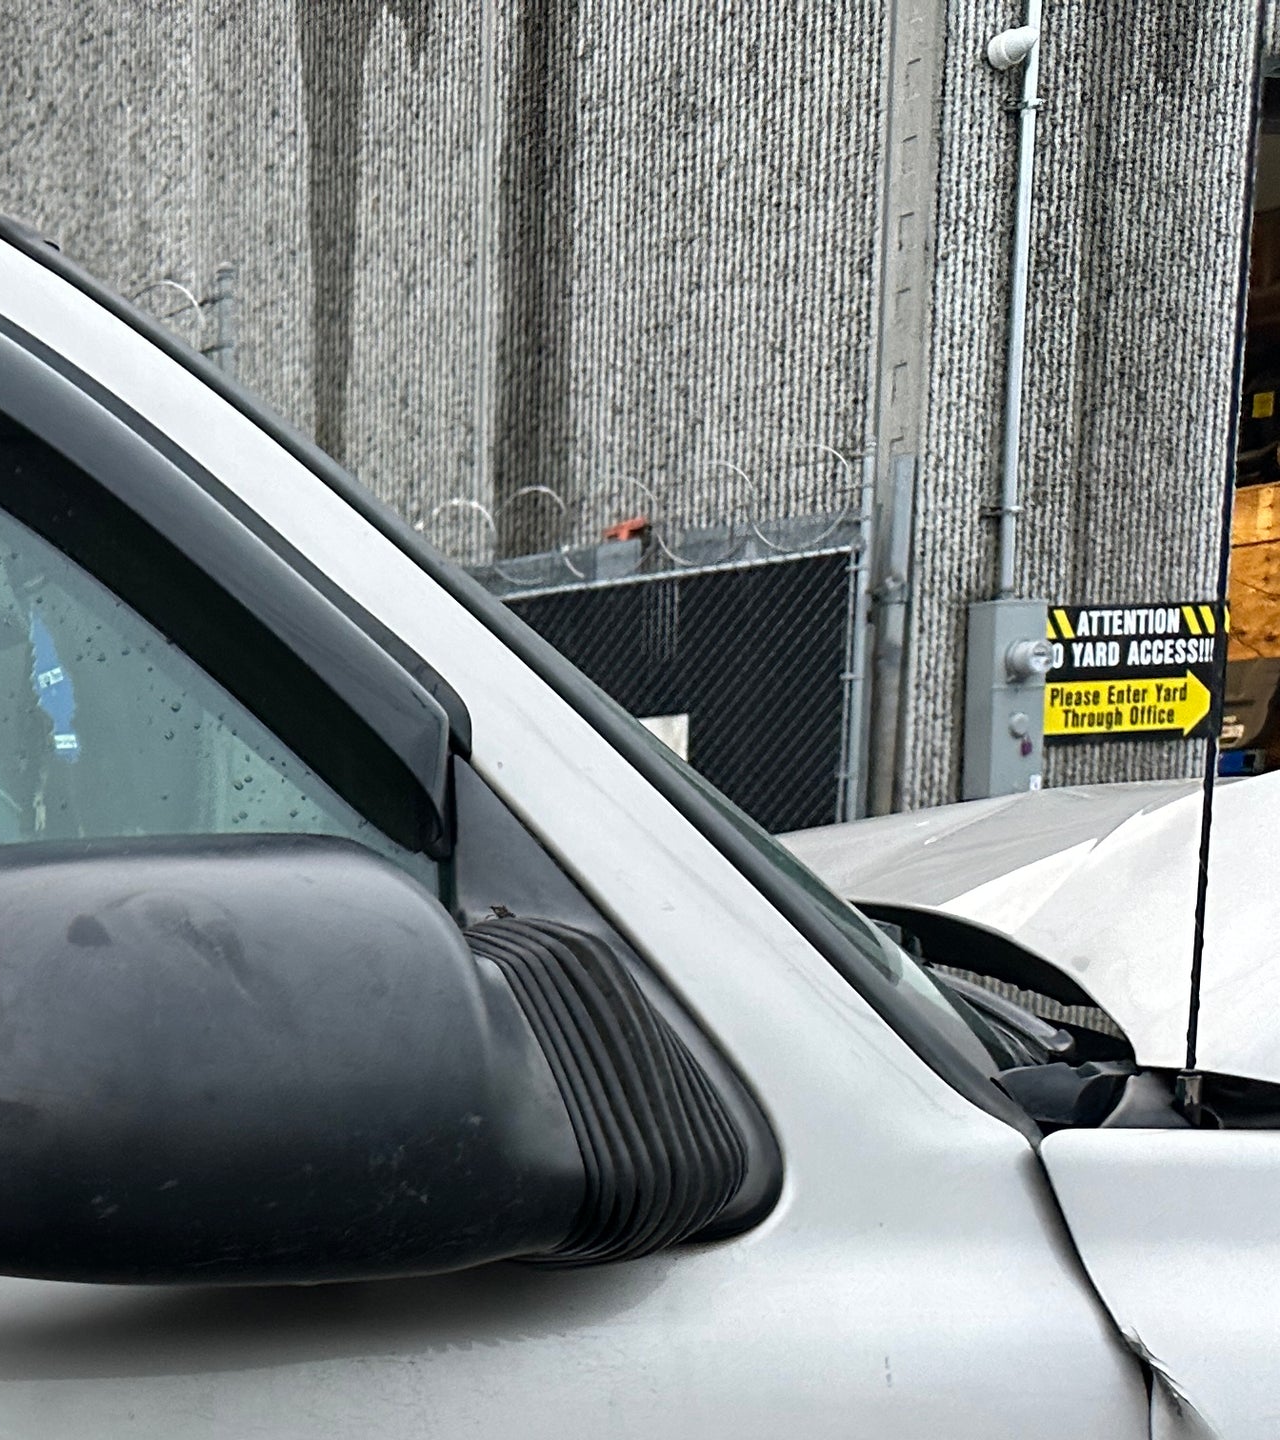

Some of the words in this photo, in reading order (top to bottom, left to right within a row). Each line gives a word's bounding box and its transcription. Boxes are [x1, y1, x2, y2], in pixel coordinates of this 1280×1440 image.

[1076, 608, 1180, 637] ATTENTION
[1052, 642, 1064, 669] O
[1071, 641, 1120, 668] YARD
[1127, 637, 1215, 666] ACCESS!!!
[1049, 686, 1100, 708] Please
[1107, 685, 1148, 706] Enter
[1155, 682, 1188, 703] Yard
[1062, 707, 1123, 730] Through
[1130, 705, 1174, 725] Office
